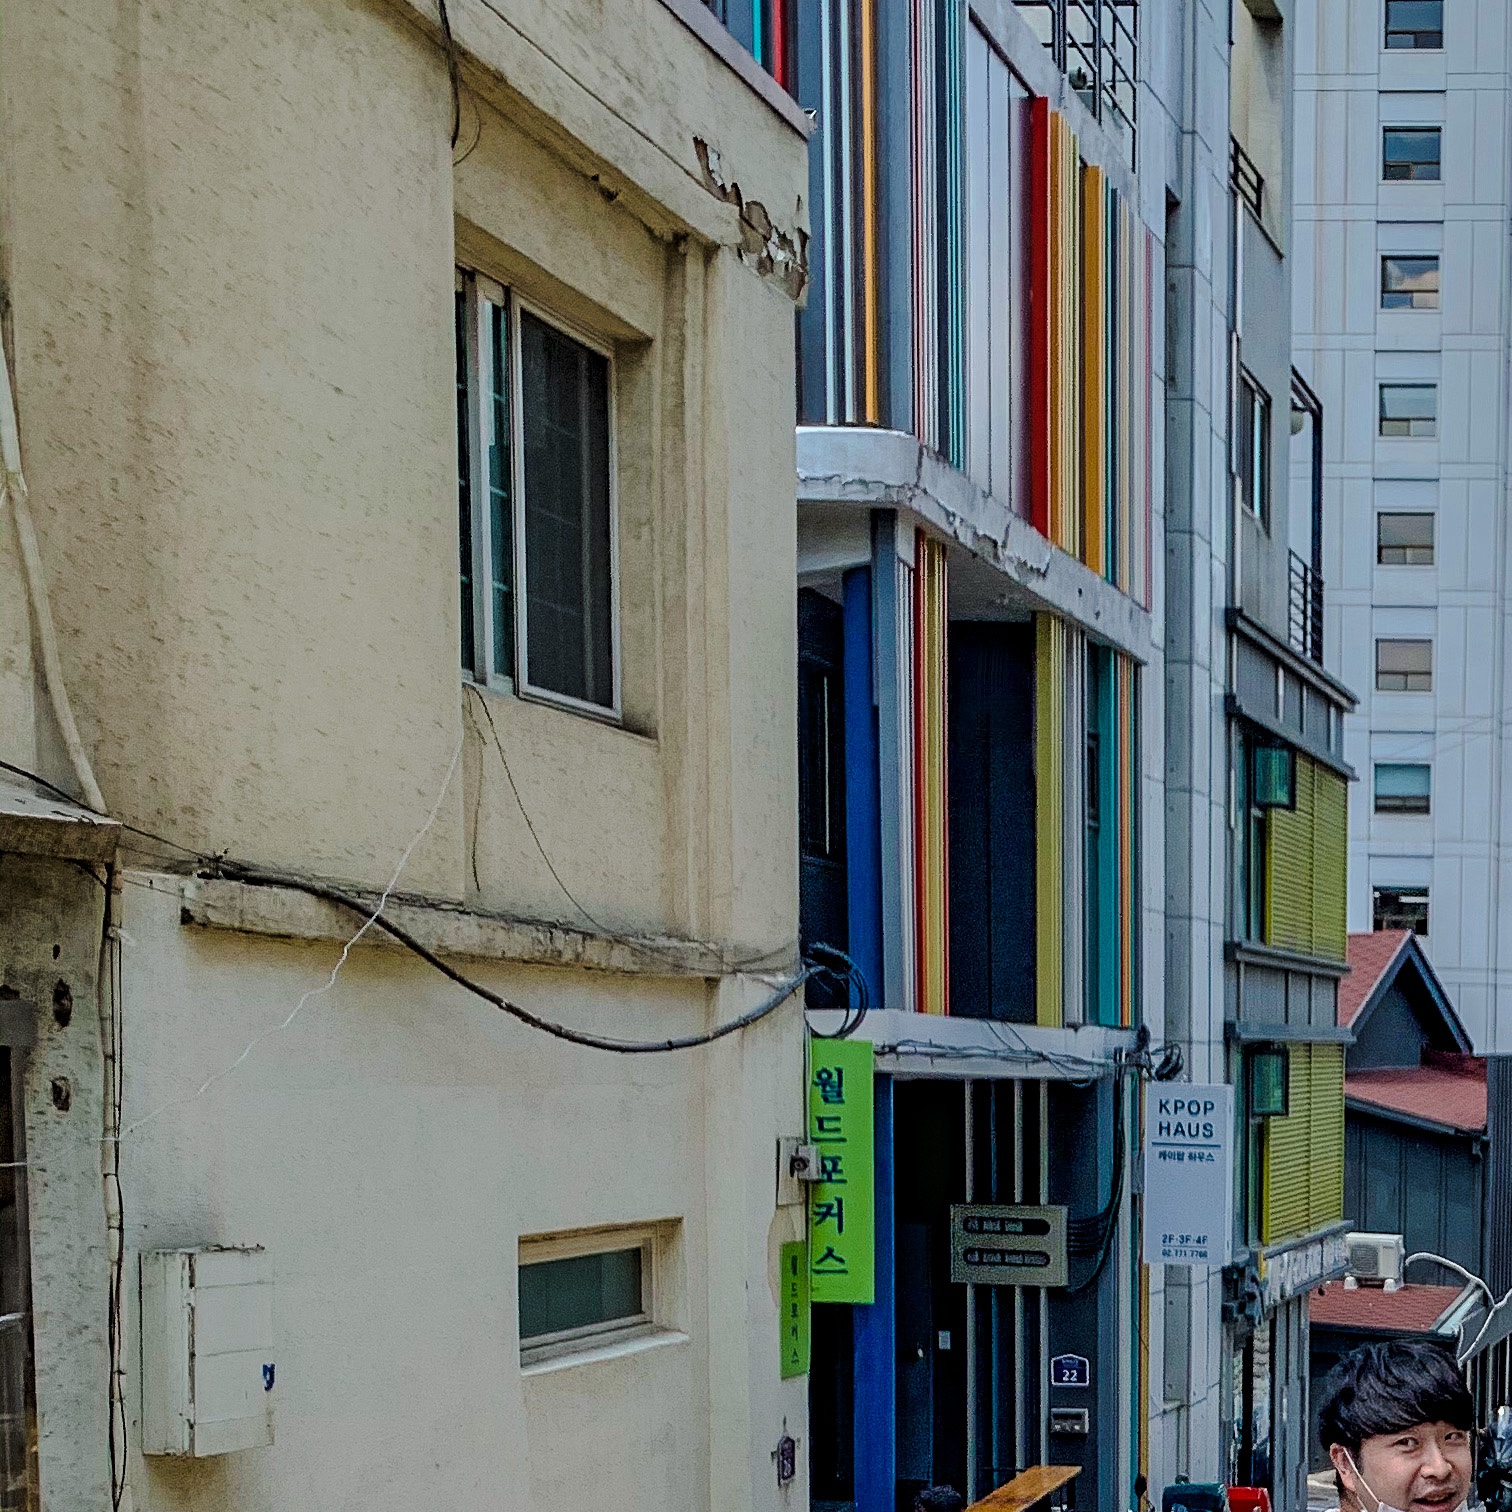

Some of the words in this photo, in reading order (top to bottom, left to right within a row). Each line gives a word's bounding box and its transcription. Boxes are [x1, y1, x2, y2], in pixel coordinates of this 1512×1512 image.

[1158, 1098, 1215, 1116] KPOP
[1158, 1120, 1214, 1138] HAUS
[1187, 1151, 1215, 1162] 하우스
[811, 1066, 849, 1276] 월드포커스
[1062, 1369, 1079, 1382] 22
